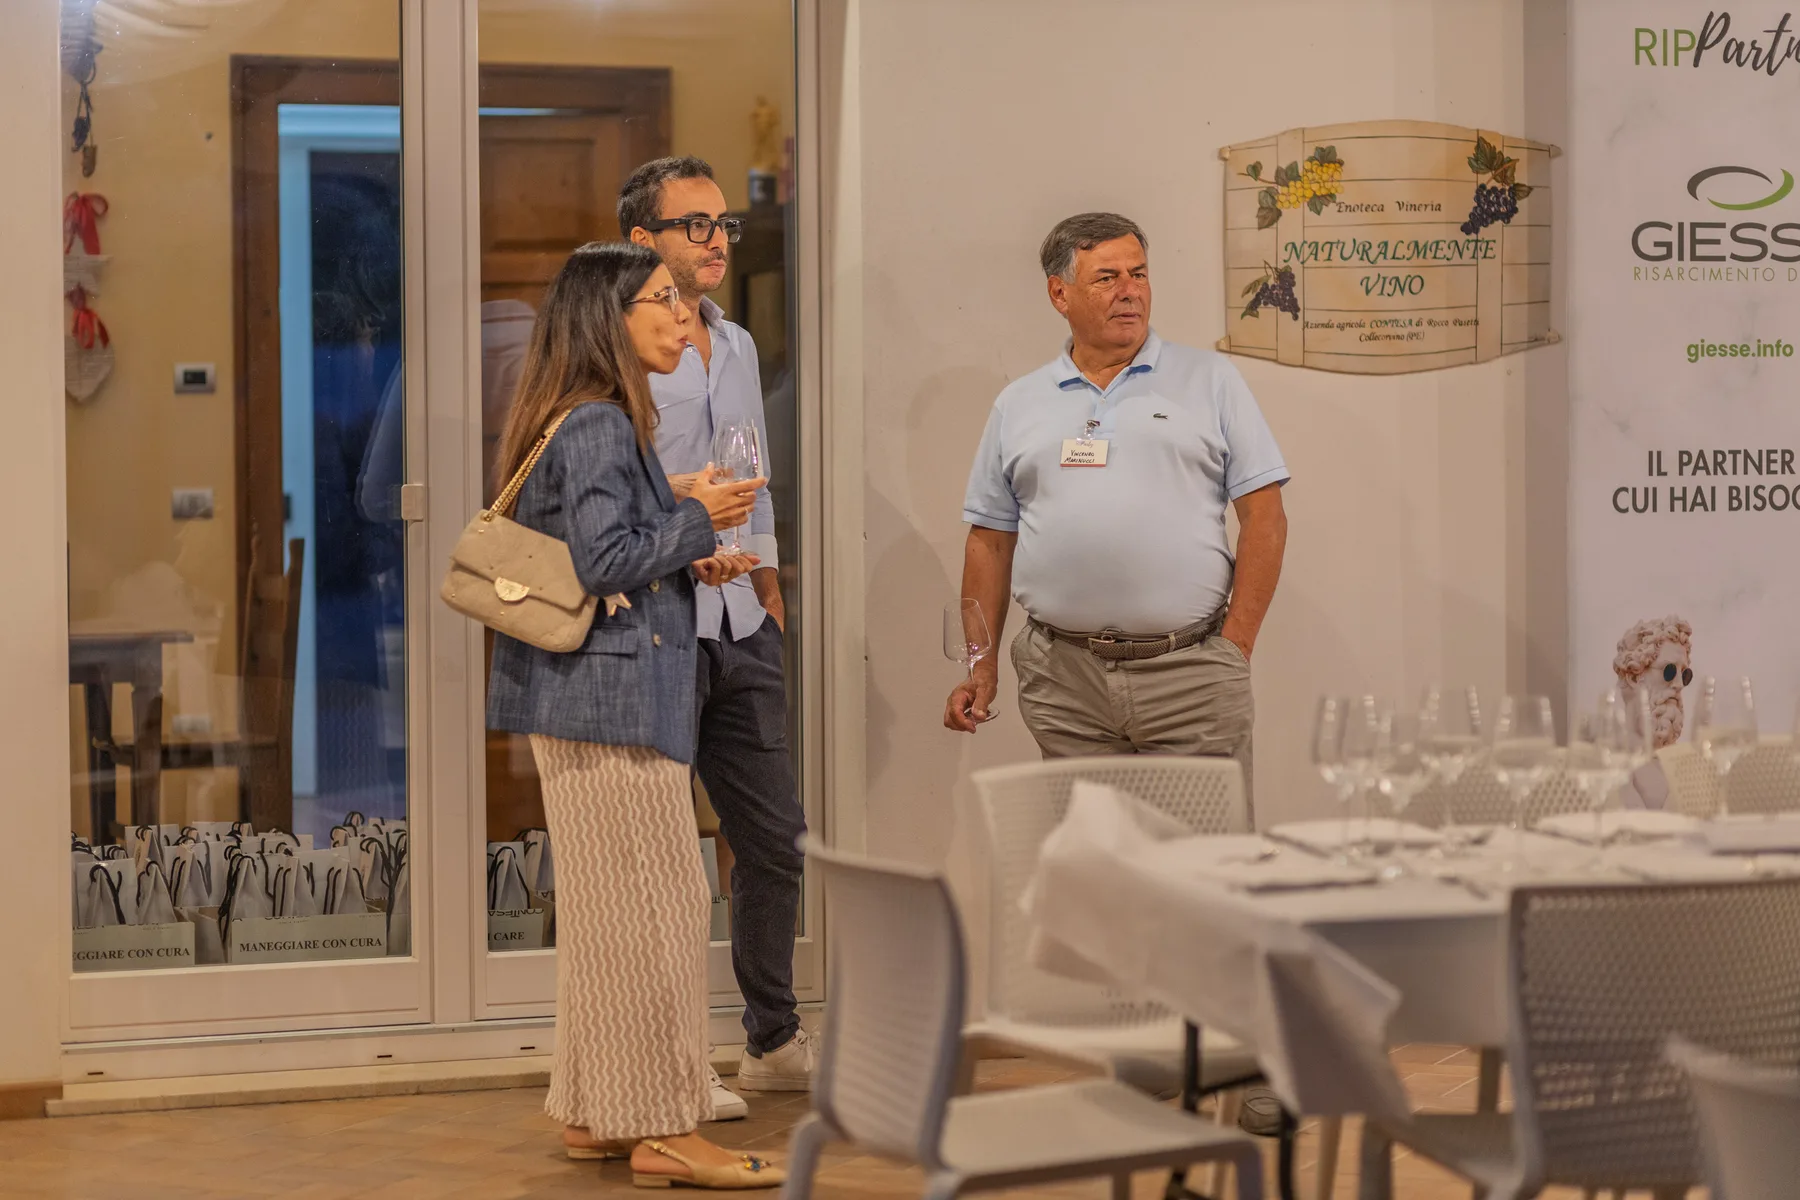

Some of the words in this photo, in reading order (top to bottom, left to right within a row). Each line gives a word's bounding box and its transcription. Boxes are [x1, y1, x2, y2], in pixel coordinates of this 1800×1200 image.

[1336, 201, 1385, 213] Enoteca
[1396, 200, 1442, 212] Vineria
[1283, 238, 1497, 264] NATURALMENTE
[1631, 220, 1800, 263] GIESS
[1633, 267, 1776, 282] RISARCIMENTO
[1360, 274, 1425, 297] VINO
[1336, 319, 1366, 332] agricola
[1370, 318, 1413, 329] CONTESA
[1415, 317, 1424, 328] di
[1426, 318, 1450, 329] Rocco
[1687, 339, 1794, 363] giesse.info
[1648, 450, 1668, 477] IL
[1678, 449, 1796, 477] PARTNER
[1612, 486, 1658, 514] CUI
[1669, 485, 1716, 513] HAI
[239, 938, 320, 953] MANEGGIARE
[322, 937, 348, 949] CON
[349, 936, 383, 948] CURA
[493, 931, 525, 942] CARE
[128, 948, 154, 959] CON
[156, 947, 190, 958] CURA
